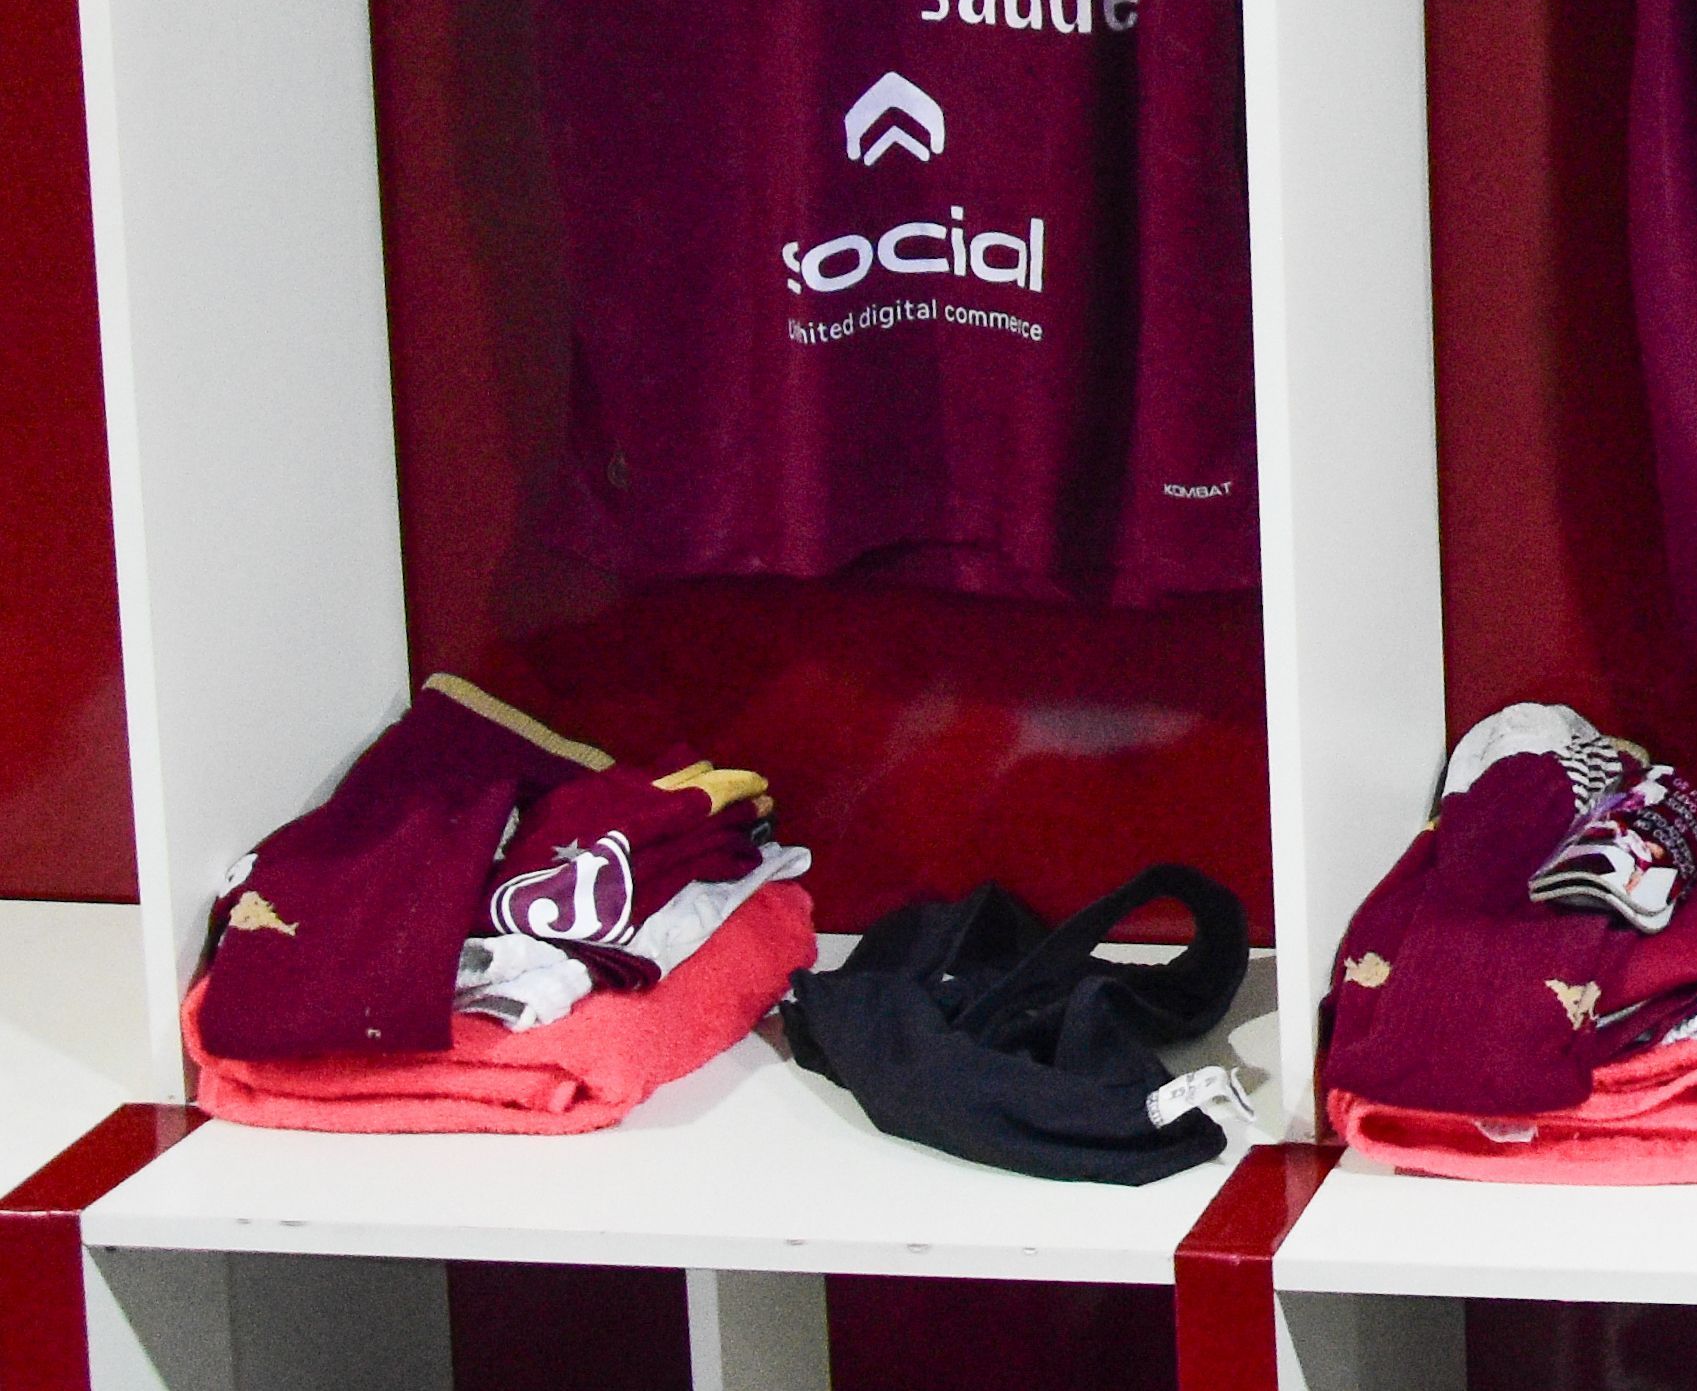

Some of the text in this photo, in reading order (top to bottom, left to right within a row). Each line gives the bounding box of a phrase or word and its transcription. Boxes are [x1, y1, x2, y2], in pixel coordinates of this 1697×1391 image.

[858, 299, 938, 329] digital
[944, 304, 1044, 342] commerce
[1163, 481, 1232, 499] KOMBAT
